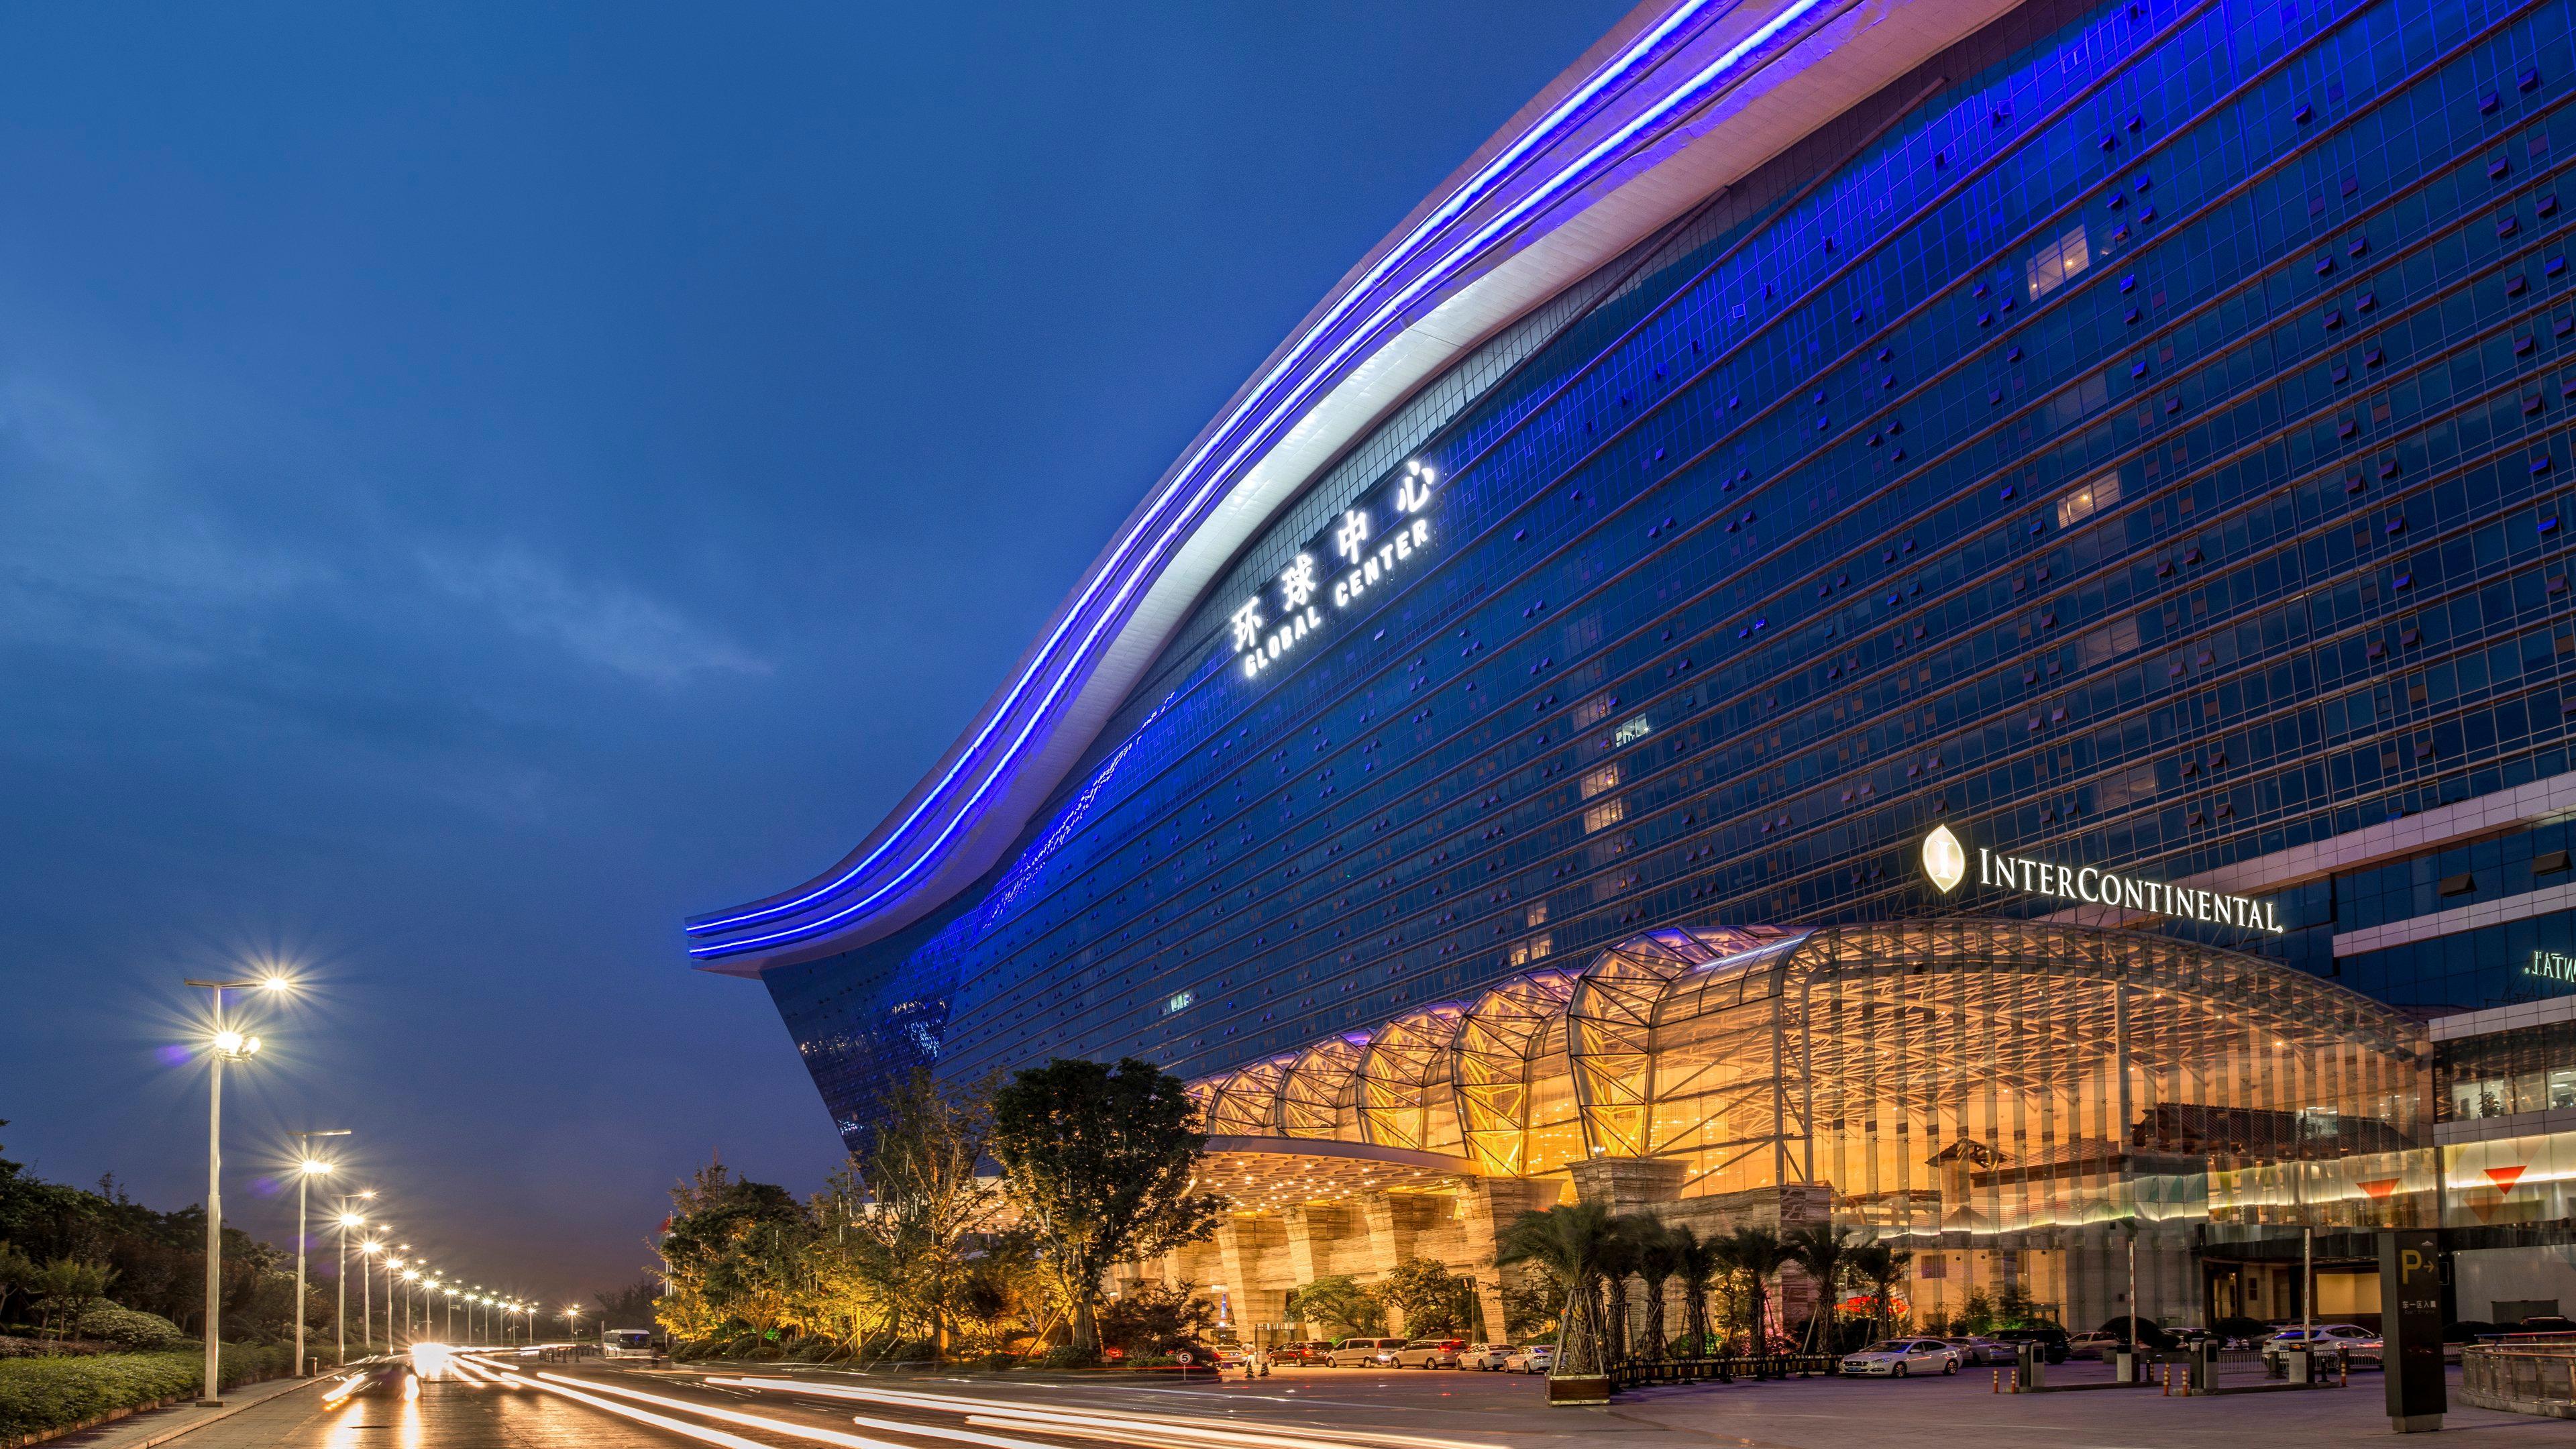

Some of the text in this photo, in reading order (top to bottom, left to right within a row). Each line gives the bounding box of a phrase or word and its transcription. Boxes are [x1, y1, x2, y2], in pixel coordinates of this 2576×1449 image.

[1232, 461, 1434, 652] 环球中心
[1244, 519, 1429, 677] GLOBAL CENTER
[2402, 1249, 2422, 1285] P
